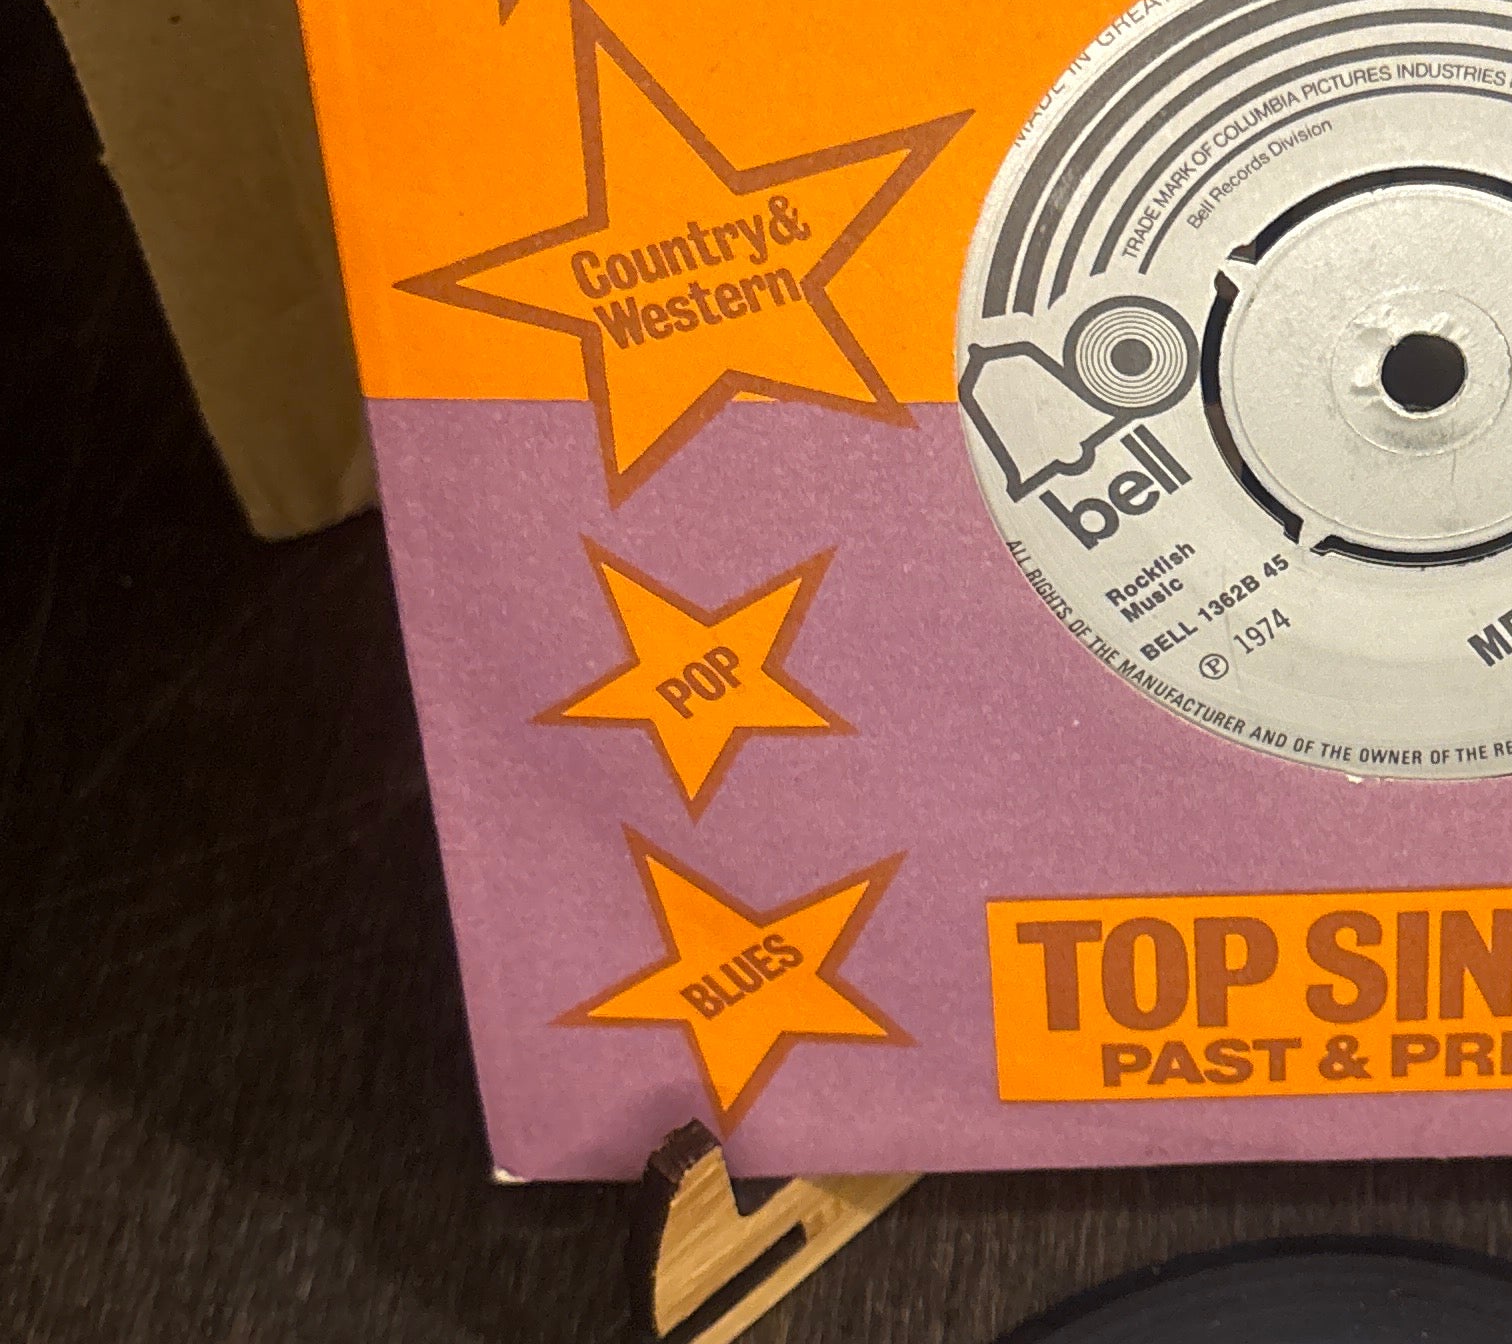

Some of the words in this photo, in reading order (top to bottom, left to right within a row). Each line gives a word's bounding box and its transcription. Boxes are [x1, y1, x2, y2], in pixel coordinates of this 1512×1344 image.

[1067, 52, 1092, 76] IN
[1121, 205, 1162, 260] TRADE
[1158, 161, 1197, 210] MARK
[1191, 141, 1217, 167] OF
[1212, 91, 1301, 148] COLUMBIA
[1301, 65, 1393, 101] PICTURES
[1396, 62, 1506, 87] INDUSTRIES
[1186, 199, 1216, 230] Bell
[1208, 150, 1271, 203] Records
[1267, 118, 1333, 158] Division
[595, 267, 802, 350] Western
[1038, 423, 1193, 551] bell
[1105, 541, 1196, 607] Rockfish
[1120, 577, 1184, 623] Music
[1140, 621, 1199, 661] BELL
[1197, 574, 1261, 623] 1362B
[1262, 553, 1290, 579] 45
[1005, 539, 1031, 570] ALL
[1025, 567, 1073, 621] RIGHTS
[1068, 618, 1093, 639] OF
[1088, 635, 1120, 664] THE
[1117, 658, 1246, 734] MANUFACTURER
[1249, 726, 1288, 748] AND
[1293, 737, 1315, 754] OF
[1320, 743, 1353, 761] THE
[1359, 747, 1423, 765] OWNER
[1430, 749, 1451, 765] OF
[1454, 744, 1488, 763] THE
[1233, 607, 1291, 654] 1974
[655, 645, 740, 719] POP
[678, 933, 803, 1021] BLUES
[1016, 915, 1279, 1031] TOP
[1101, 1037, 1302, 1087] PAST
[1318, 1032, 1372, 1080] &
